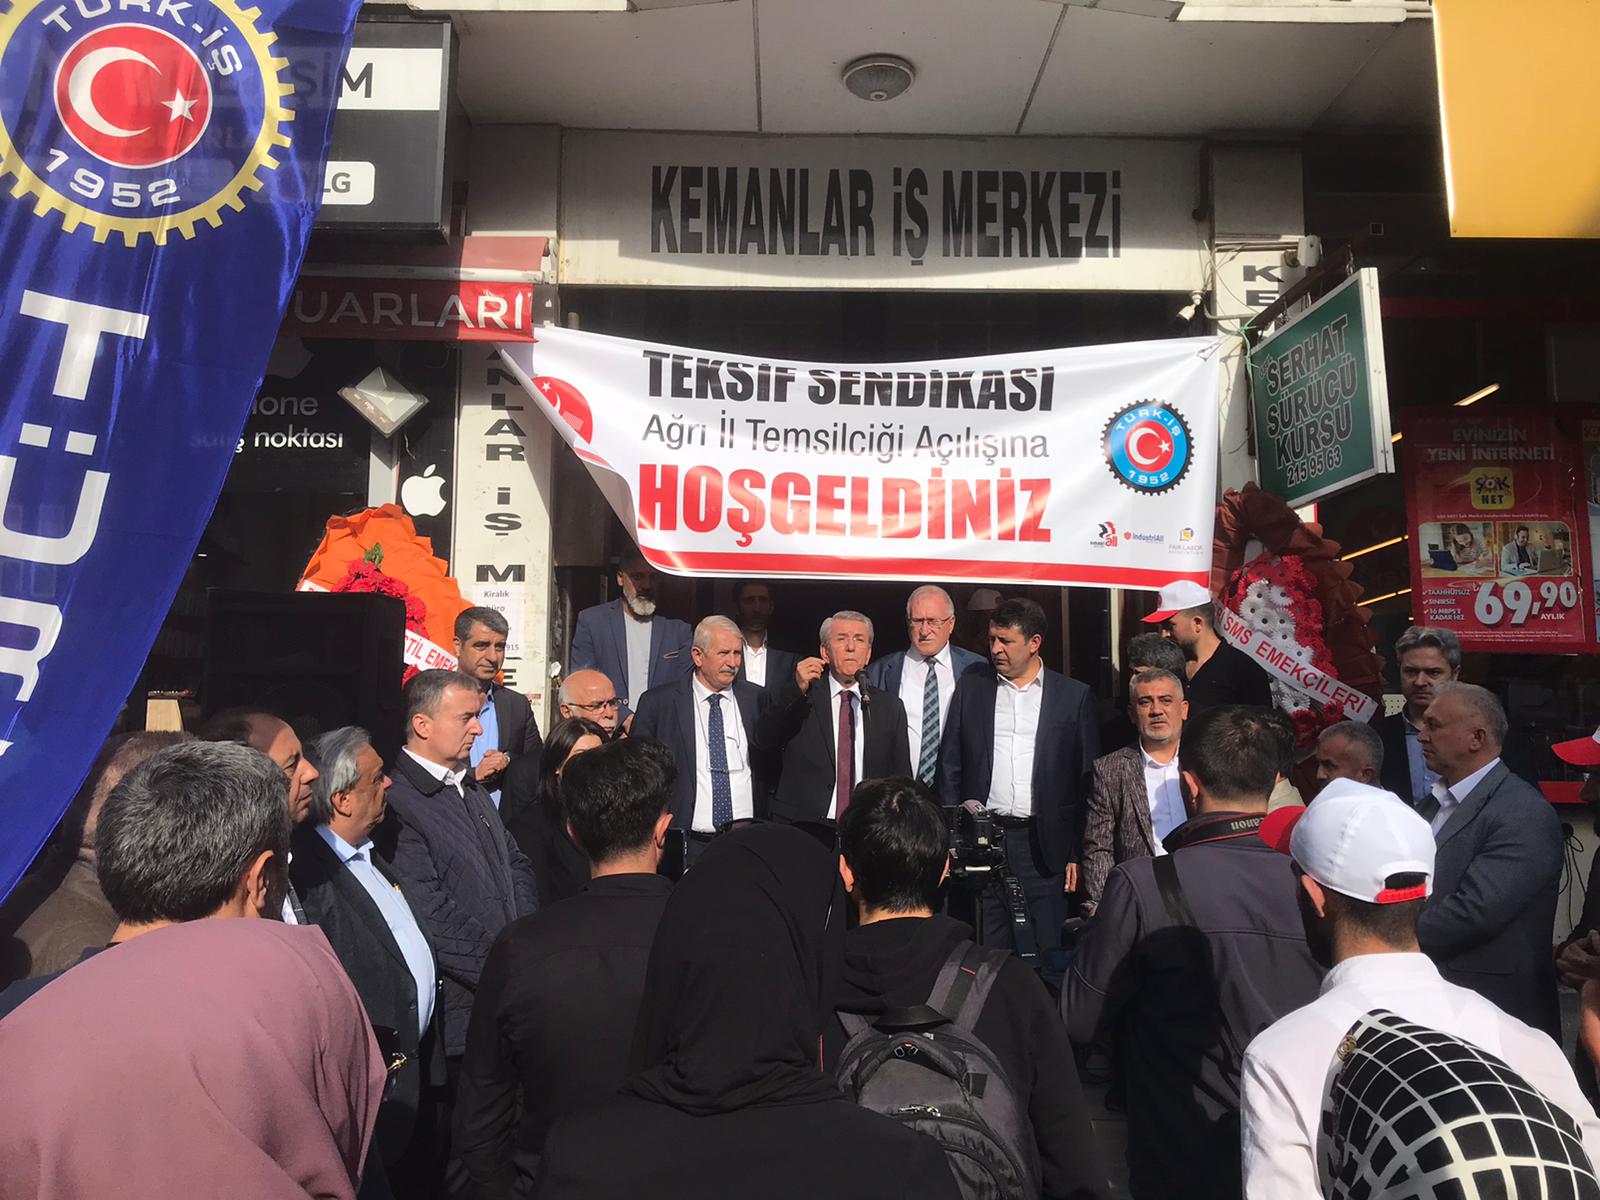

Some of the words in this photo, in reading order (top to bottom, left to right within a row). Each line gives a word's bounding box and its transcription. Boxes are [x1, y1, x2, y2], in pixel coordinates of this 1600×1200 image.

[46, 148, 181, 208] 1952
[651, 166, 875, 257] KEMANLAR
[893, 167, 928, 265] İŞ
[942, 170, 1120, 258] MERKEZİ
[643, 350, 796, 402] TEKSİF
[808, 365, 1055, 411] SENDİKASI
[1267, 313, 1348, 397] SERHAT
[1266, 353, 1358, 438] SÜRÜCÜ
[254, 423, 344, 448] noktası
[641, 413, 706, 450] Ağrı
[720, 410, 735, 448] İl
[746, 418, 903, 464] Temsilciği
[913, 425, 1050, 466] Açılışına
[1275, 401, 1352, 470] KURSU
[1427, 444, 1466, 461] YENİ
[1472, 443, 1555, 461] İNTERNETİ
[1128, 470, 1169, 485] 1952
[1287, 463, 1307, 488] 215
[1310, 455, 1324, 477] 95
[1326, 445, 1342, 469] 63
[638, 463, 1051, 547] HOŞGELDİNİZ
[1482, 495, 1504, 504] NET
[484, 590, 510, 598] Kiralık
[1474, 581, 1577, 625] 69,90
[1223, 616, 1253, 645] SMS
[1255, 640, 1368, 714] EMEKÇİLERİ
